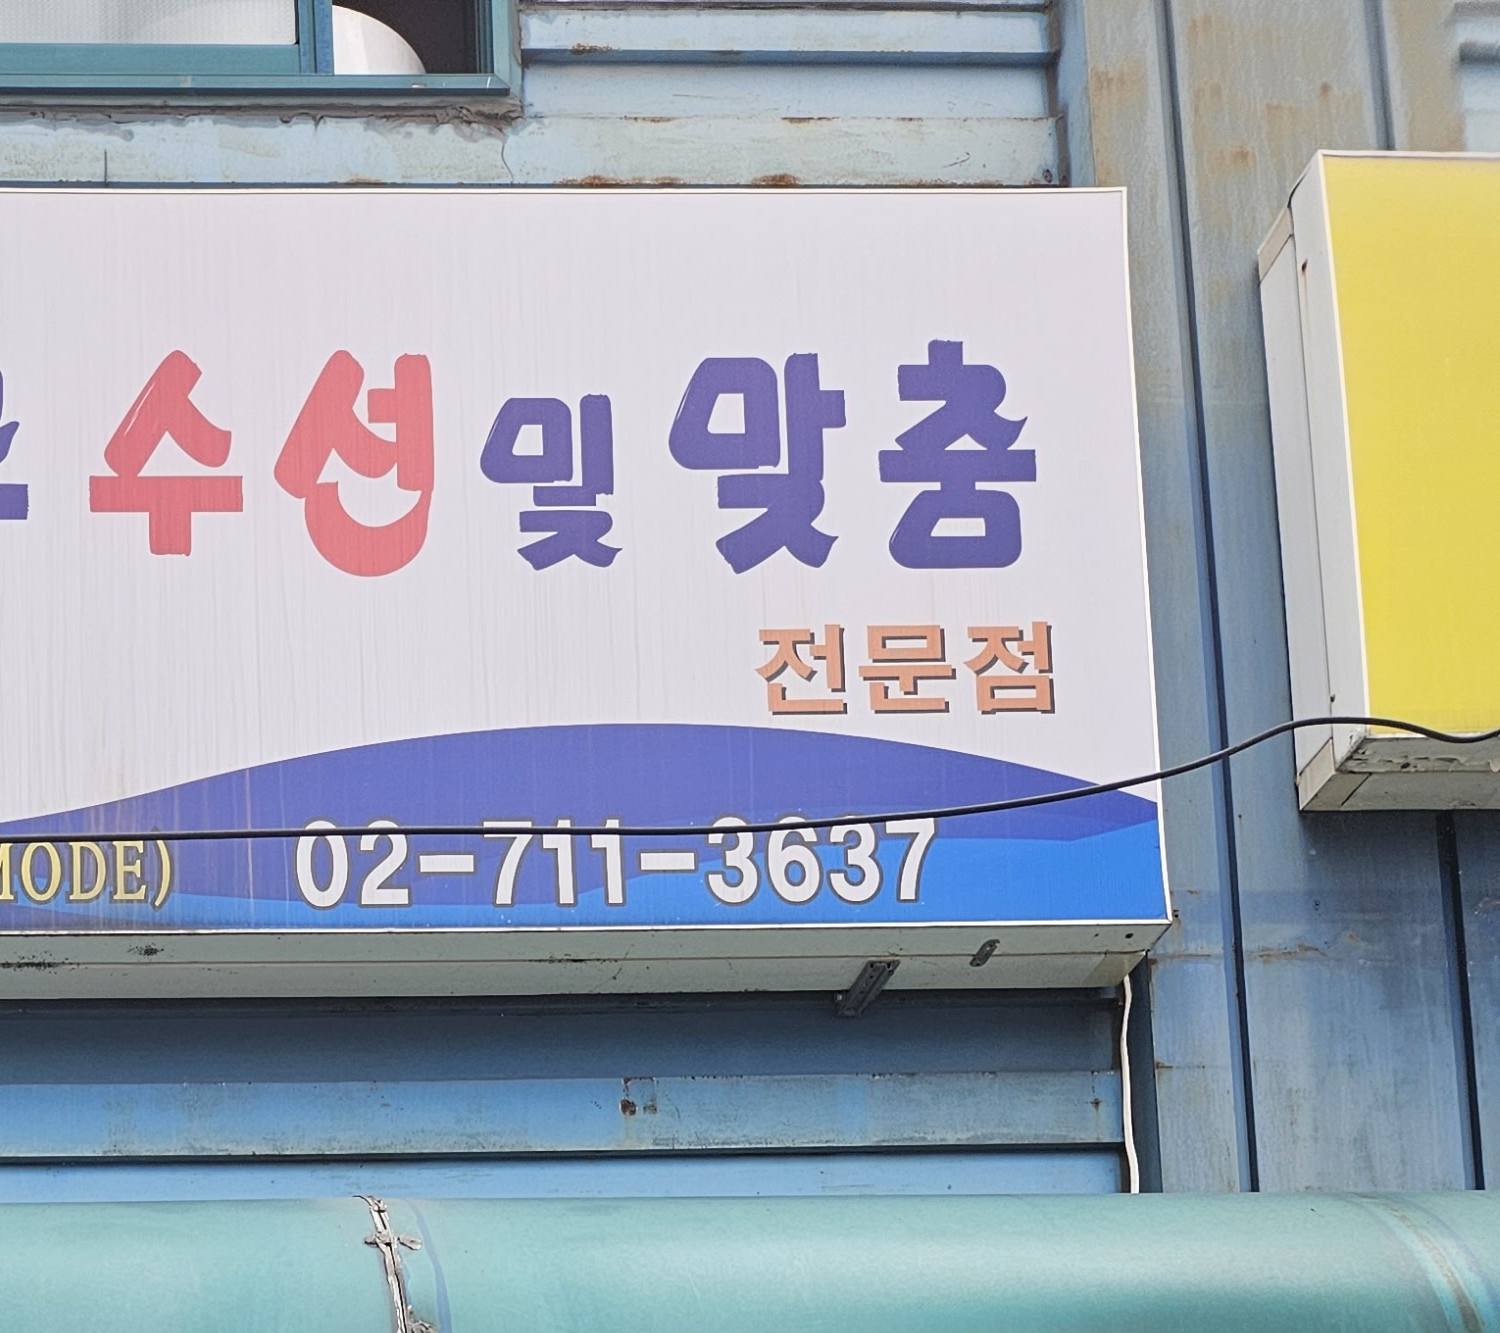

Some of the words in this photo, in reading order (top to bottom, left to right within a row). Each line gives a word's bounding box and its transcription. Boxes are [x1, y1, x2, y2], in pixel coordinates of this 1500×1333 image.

[89, 349, 434, 577] 수선
[480, 393, 622, 571] 및
[668, 339, 1036, 574] 맞춤
[755, 621, 1055, 715] 전문점
[294, 815, 939, 908] 02-711-3637
